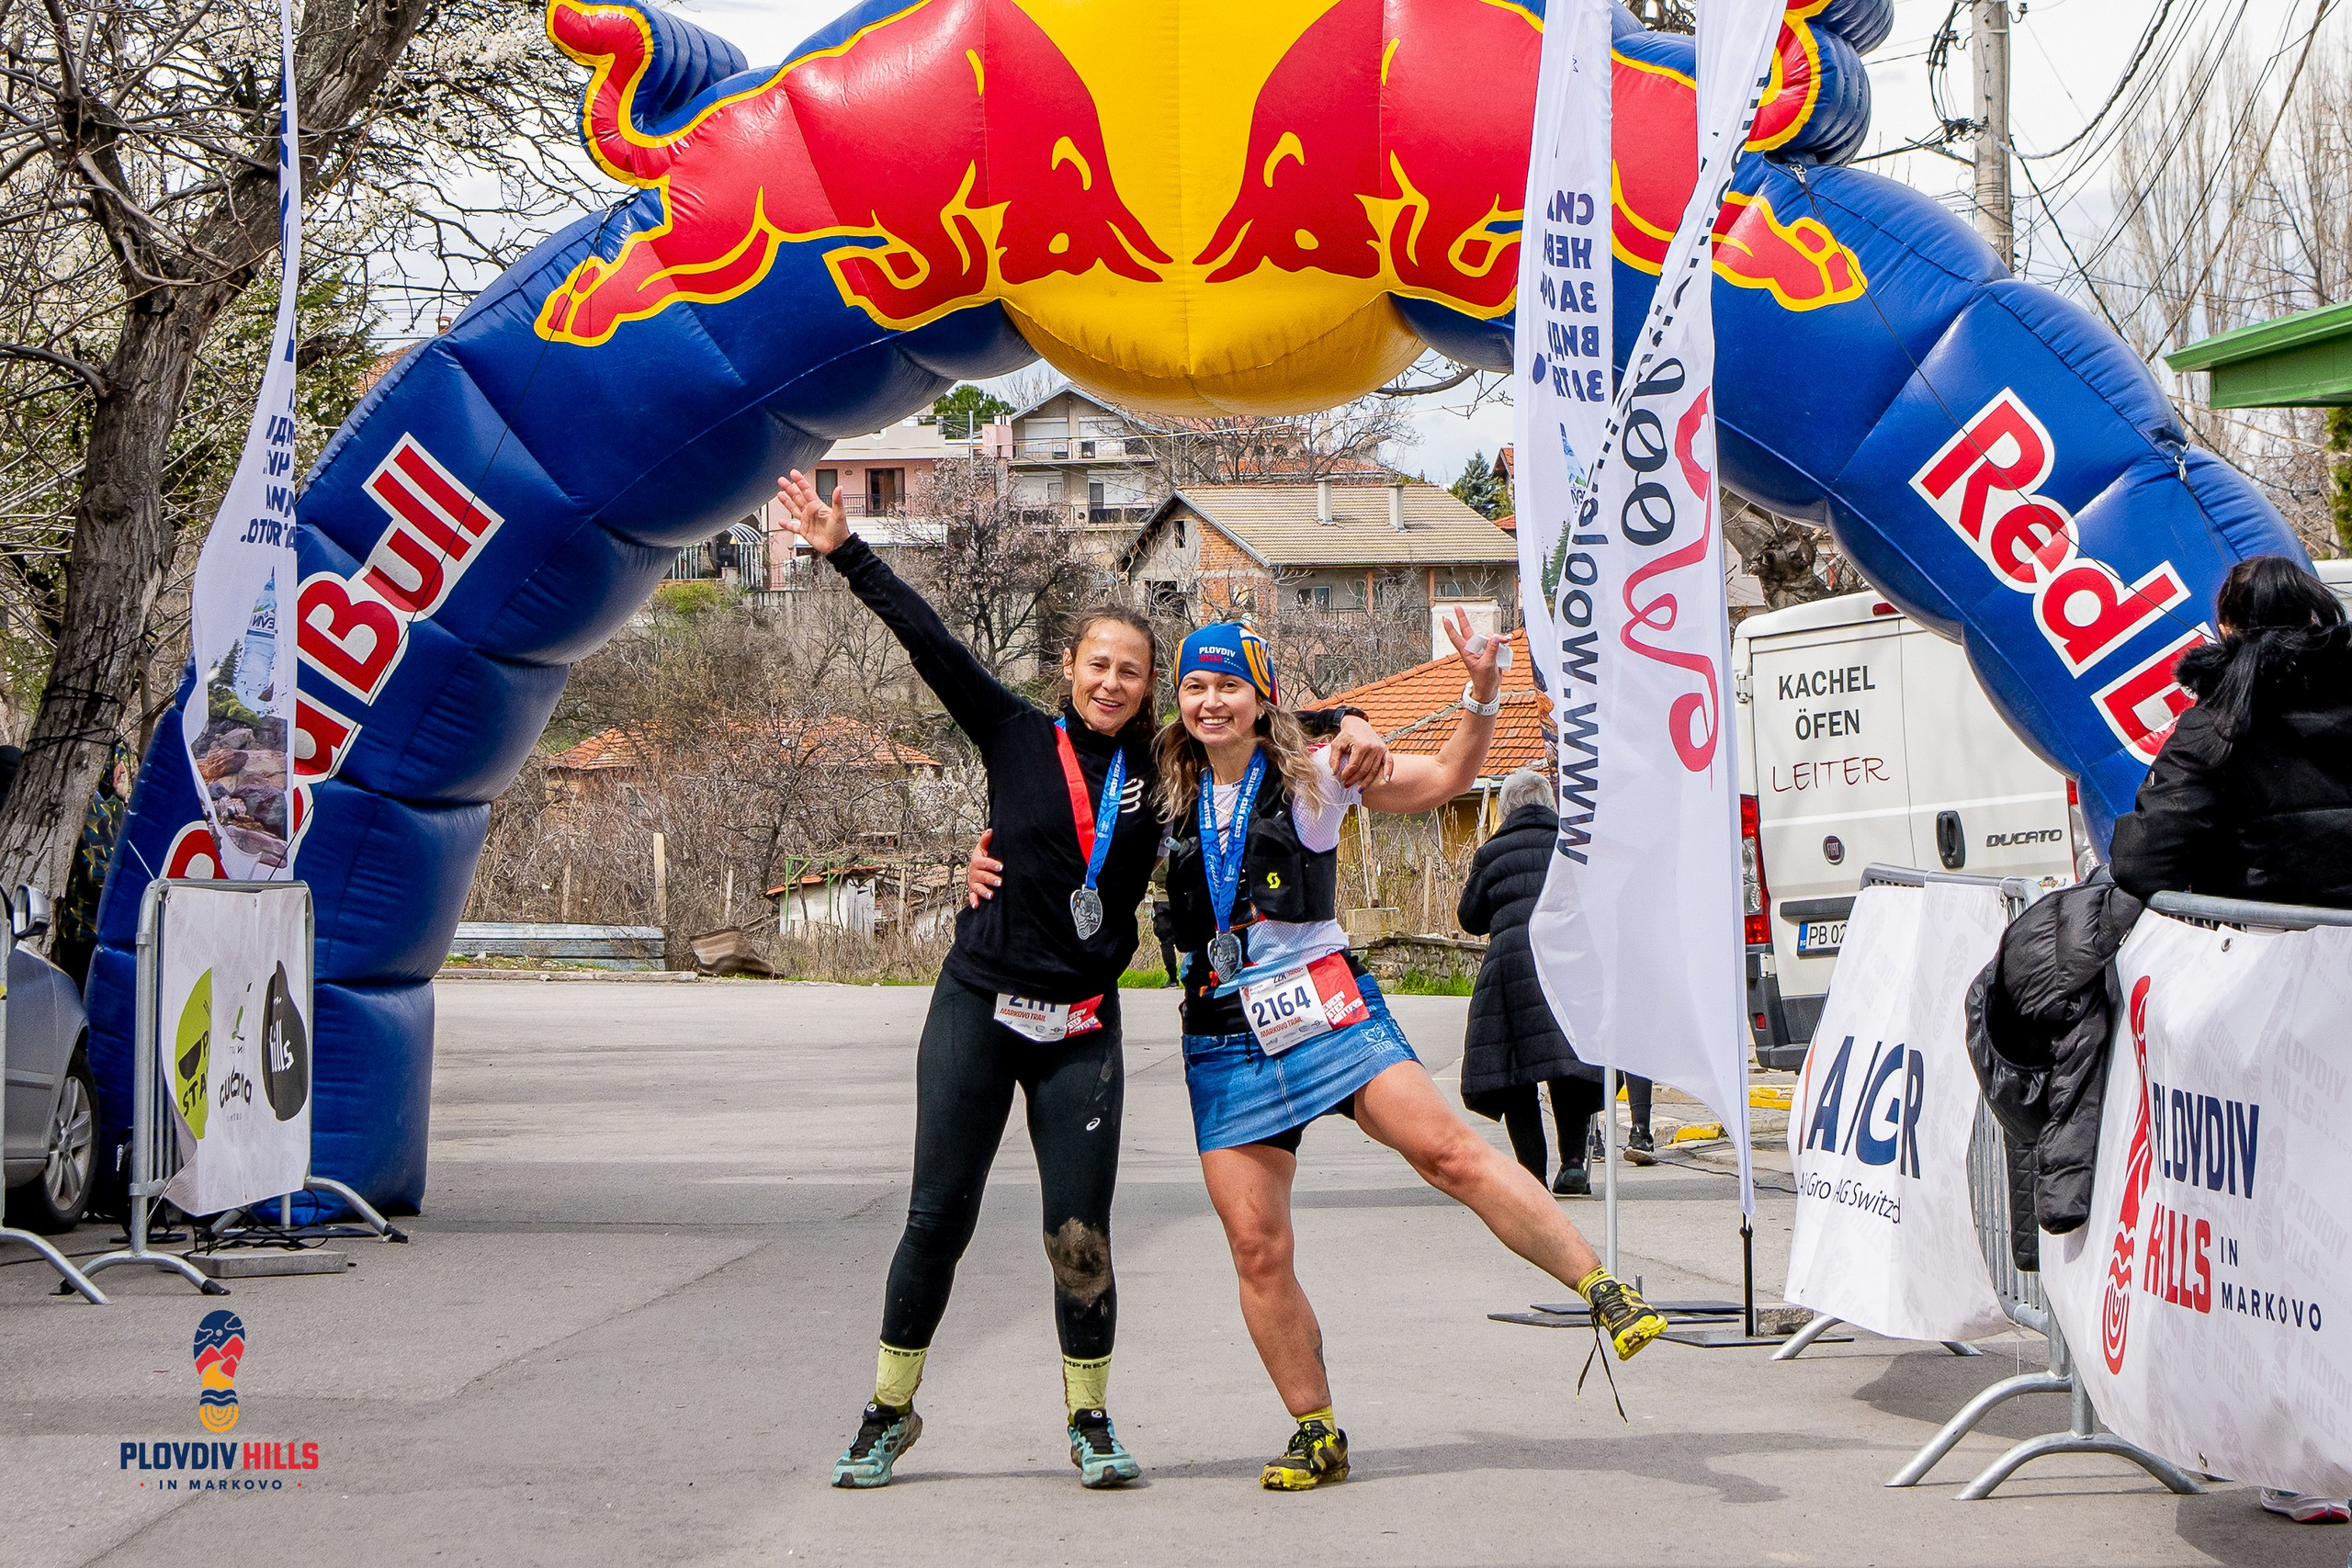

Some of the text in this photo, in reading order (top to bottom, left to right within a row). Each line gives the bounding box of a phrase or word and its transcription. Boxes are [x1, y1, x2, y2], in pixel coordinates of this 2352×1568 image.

[1917, 395, 2180, 669] Red
[297, 443, 493, 695] Bull
[1199, 646, 1236, 658] PLOVDIV
[1779, 665, 1876, 700] KACHEL
[1795, 708, 1860, 740] ÖFEN
[1772, 756, 1891, 793] LEITER
[1826, 840, 1840, 857] FIAT
[1985, 829, 2064, 848] DUCATO
[1808, 925, 1828, 947] PB
[1000, 1008, 1046, 1022] MARKOVO TRAIL
[1250, 986, 1312, 1028] 2164
[1260, 1022, 1288, 1039] MARKOVO
[1286, 1016, 1304, 1030] TRAIL
[2152, 1081, 2260, 1199] PLOVDIV
[2143, 1201, 2211, 1314] HILLS
[2220, 1235, 2238, 1268] IN
[2221, 1281, 2323, 1332] MARKOVO
